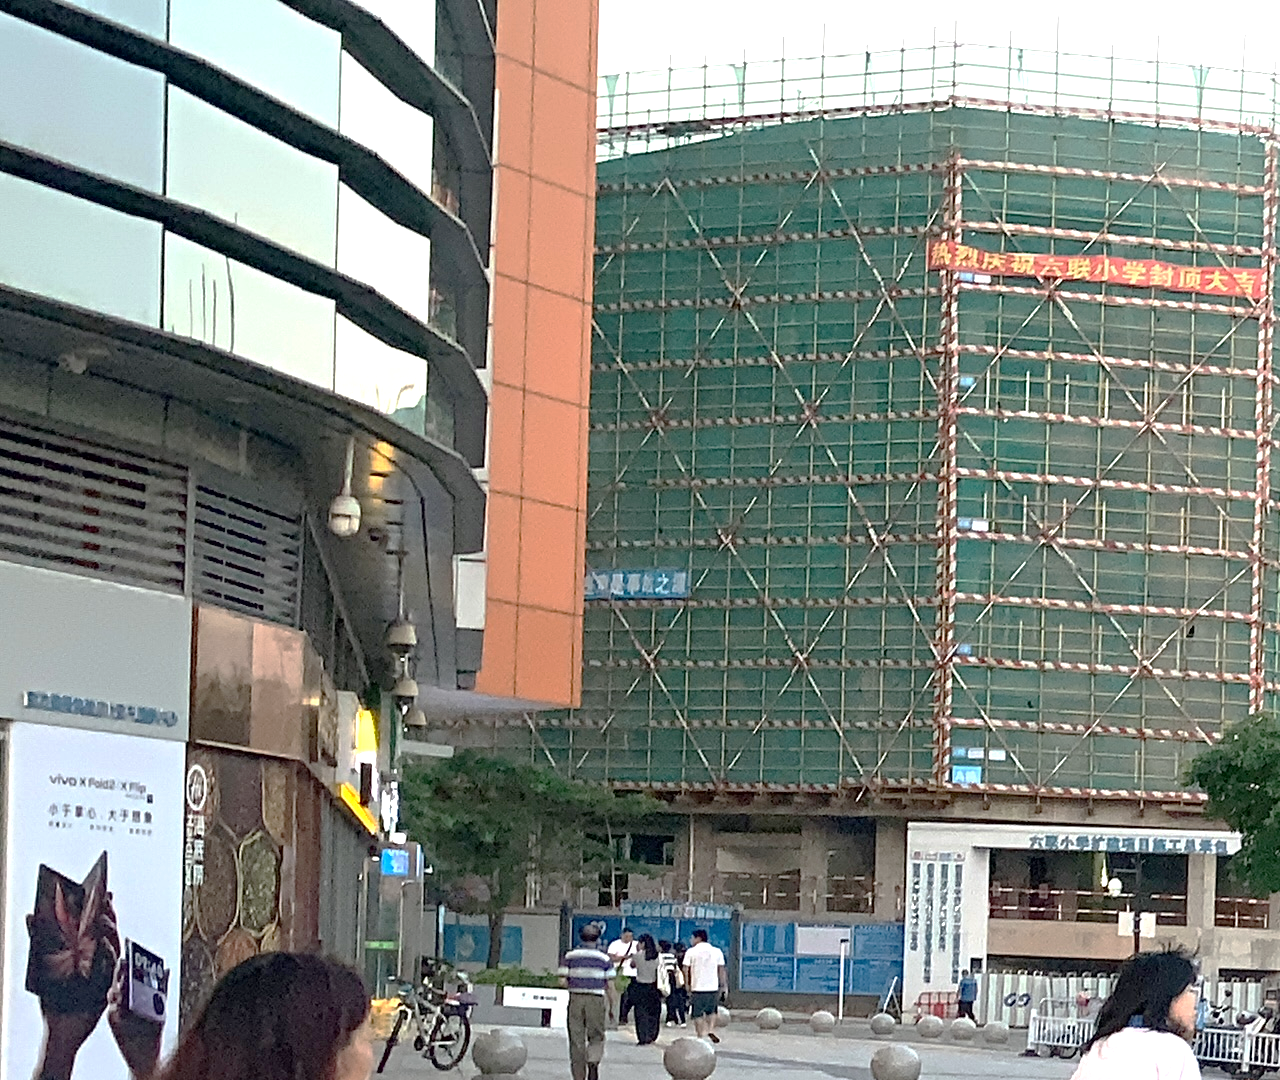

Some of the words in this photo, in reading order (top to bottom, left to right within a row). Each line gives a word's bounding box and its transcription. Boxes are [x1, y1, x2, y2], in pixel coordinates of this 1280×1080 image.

[931, 241, 1257, 294] 热烈庆祝六联小学封顶大吉
[49, 773, 77, 787] vivo
[80, 777, 87, 788] X
